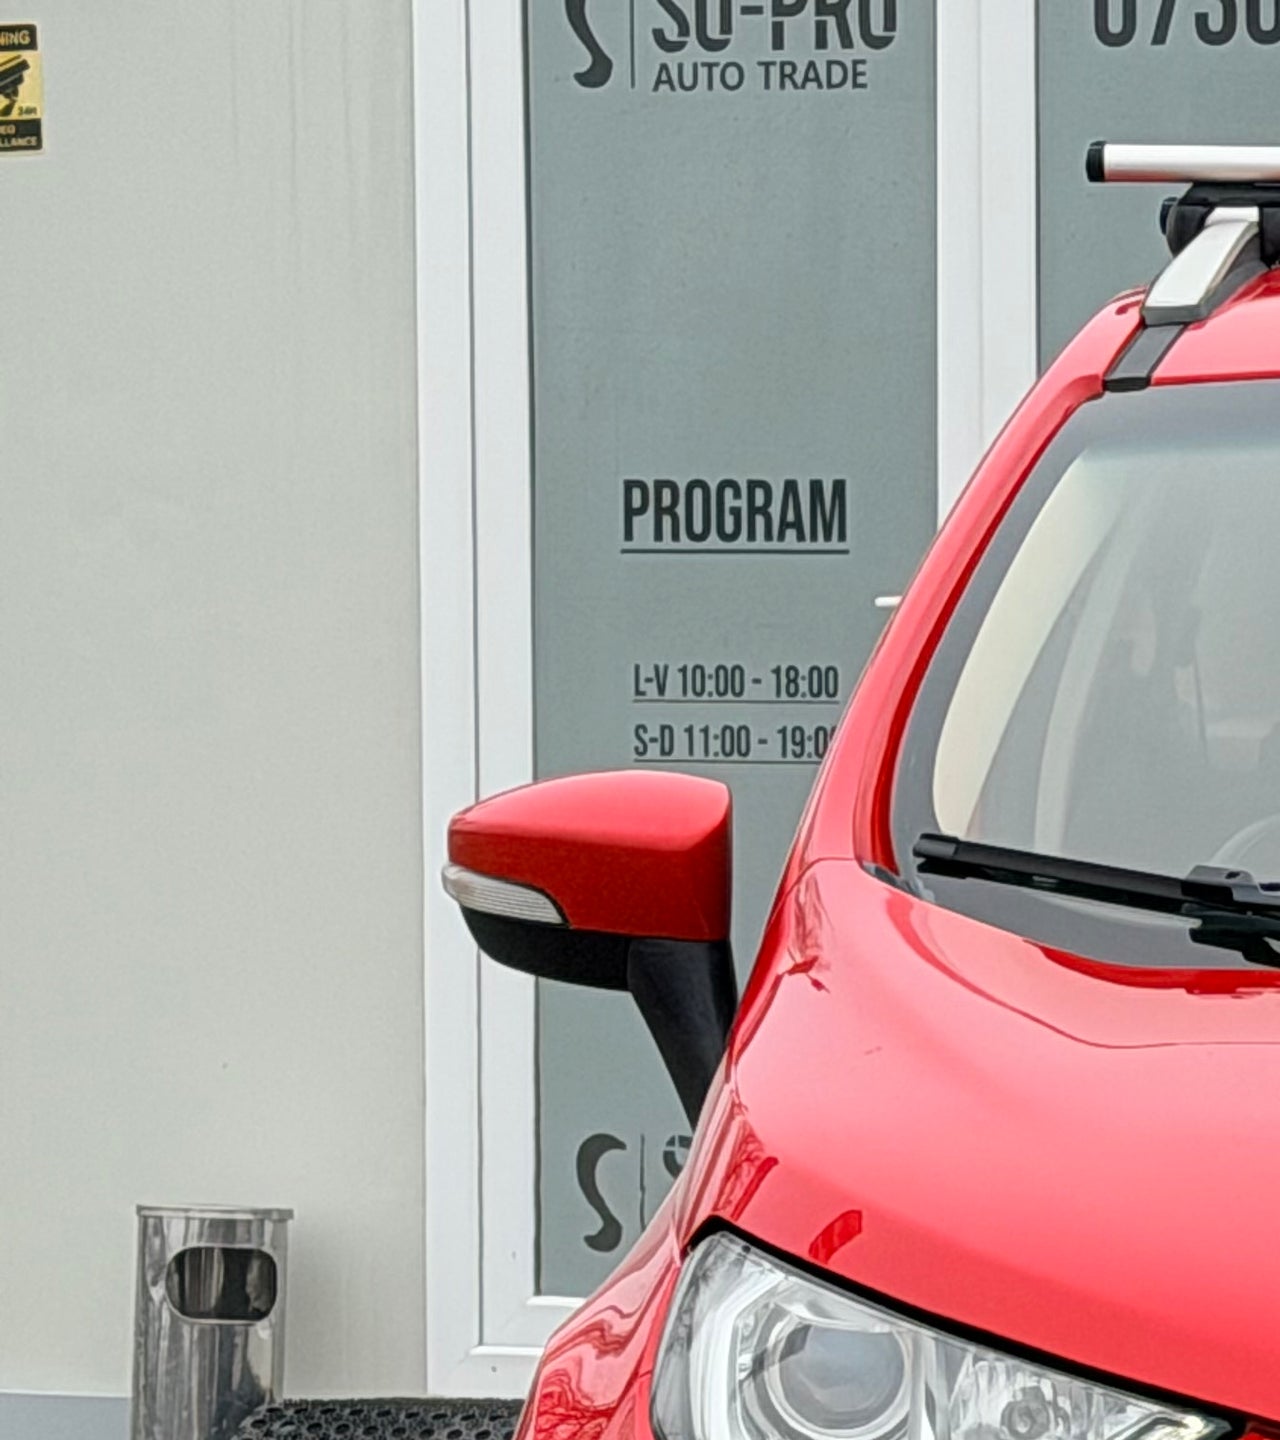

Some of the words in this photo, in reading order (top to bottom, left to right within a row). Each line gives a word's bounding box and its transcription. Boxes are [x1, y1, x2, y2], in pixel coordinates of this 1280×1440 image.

[652, 61, 745, 92] AUTO
[757, 59, 868, 91] TRADE
[623, 479, 847, 543] PROGRAM
[634, 664, 669, 697] L-V
[677, 664, 745, 698] 10:00
[770, 665, 839, 699] 18:00
[634, 724, 675, 758] S-D
[683, 724, 752, 758] 11:00
[776, 725, 838, 760] 19:0
